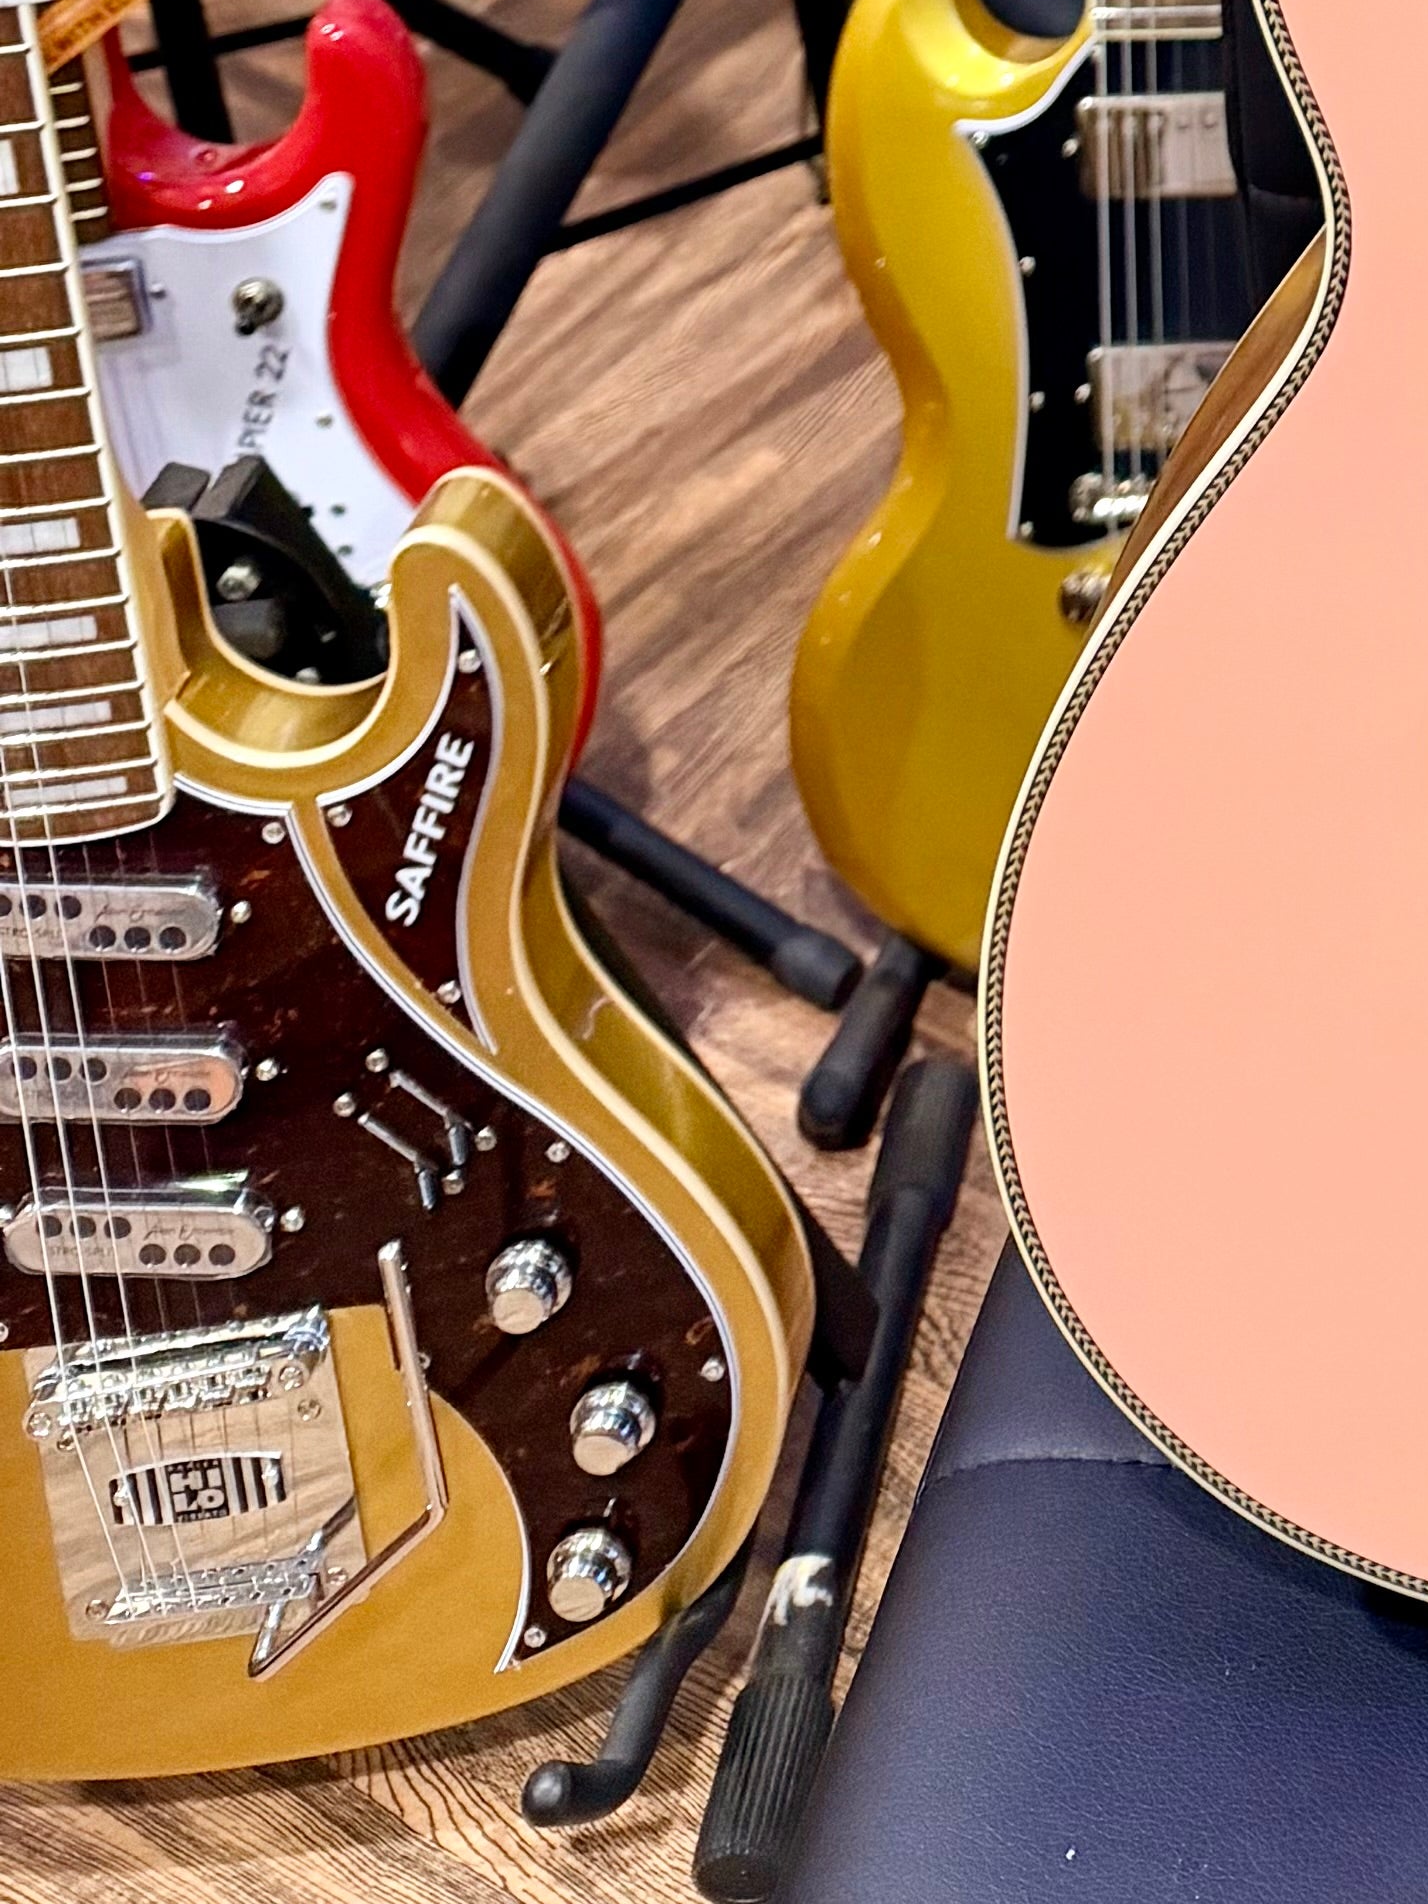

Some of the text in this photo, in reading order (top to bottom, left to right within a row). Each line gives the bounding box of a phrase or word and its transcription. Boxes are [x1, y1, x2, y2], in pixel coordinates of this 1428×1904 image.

[253, 344, 291, 382] 22
[384, 730, 476, 928] SAFFIRE
[169, 1467, 222, 1493] HI
[173, 1488, 225, 1513] LO
